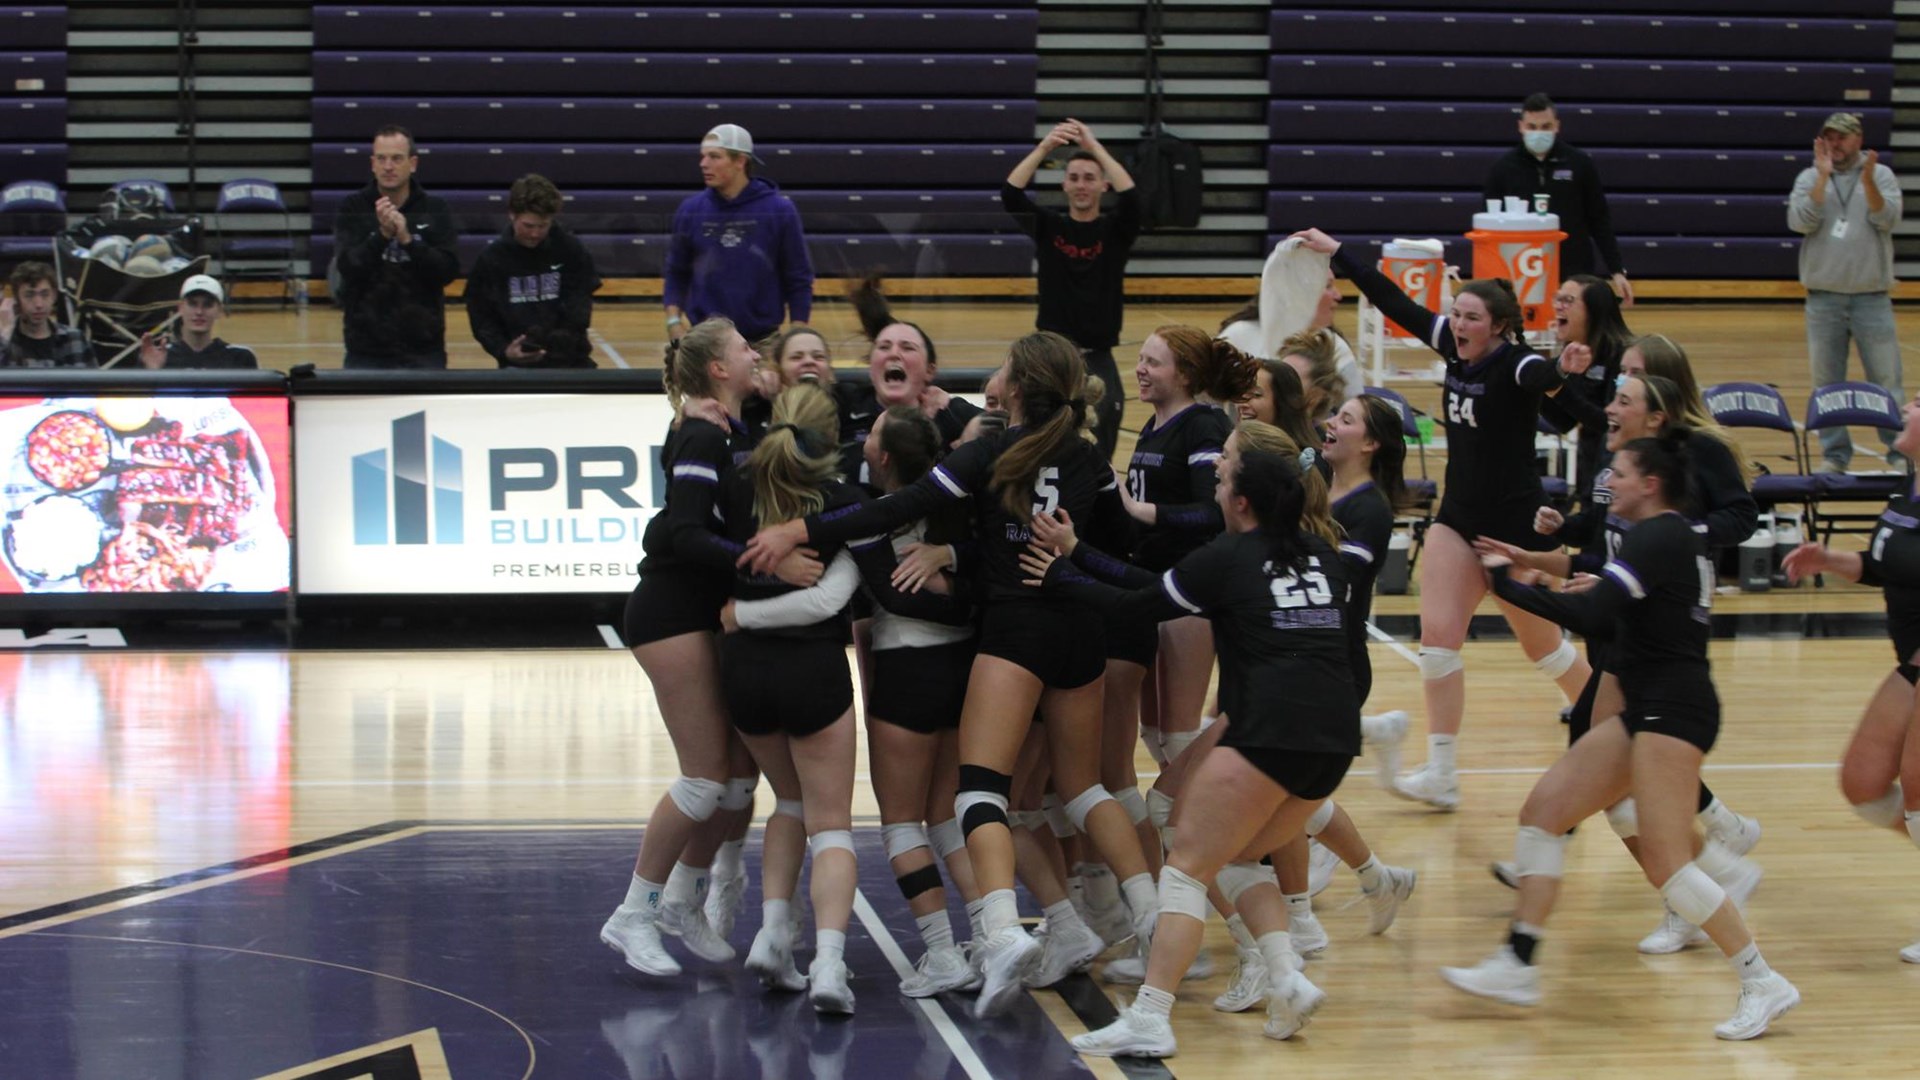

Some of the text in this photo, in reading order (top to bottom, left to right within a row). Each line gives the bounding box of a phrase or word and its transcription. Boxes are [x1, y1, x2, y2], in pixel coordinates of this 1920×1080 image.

[1518, 248, 1543, 277] G
[1404, 267, 1425, 290] G
[1448, 392, 1478, 428] 24
[1815, 390, 1890, 415] MOUNT UNION
[488, 445, 666, 511] PR
[1032, 467, 1059, 516] 5
[491, 517, 651, 544] BUILDI
[493, 563, 638, 577] PREMIERBU
[1262, 556, 1333, 608] 25
